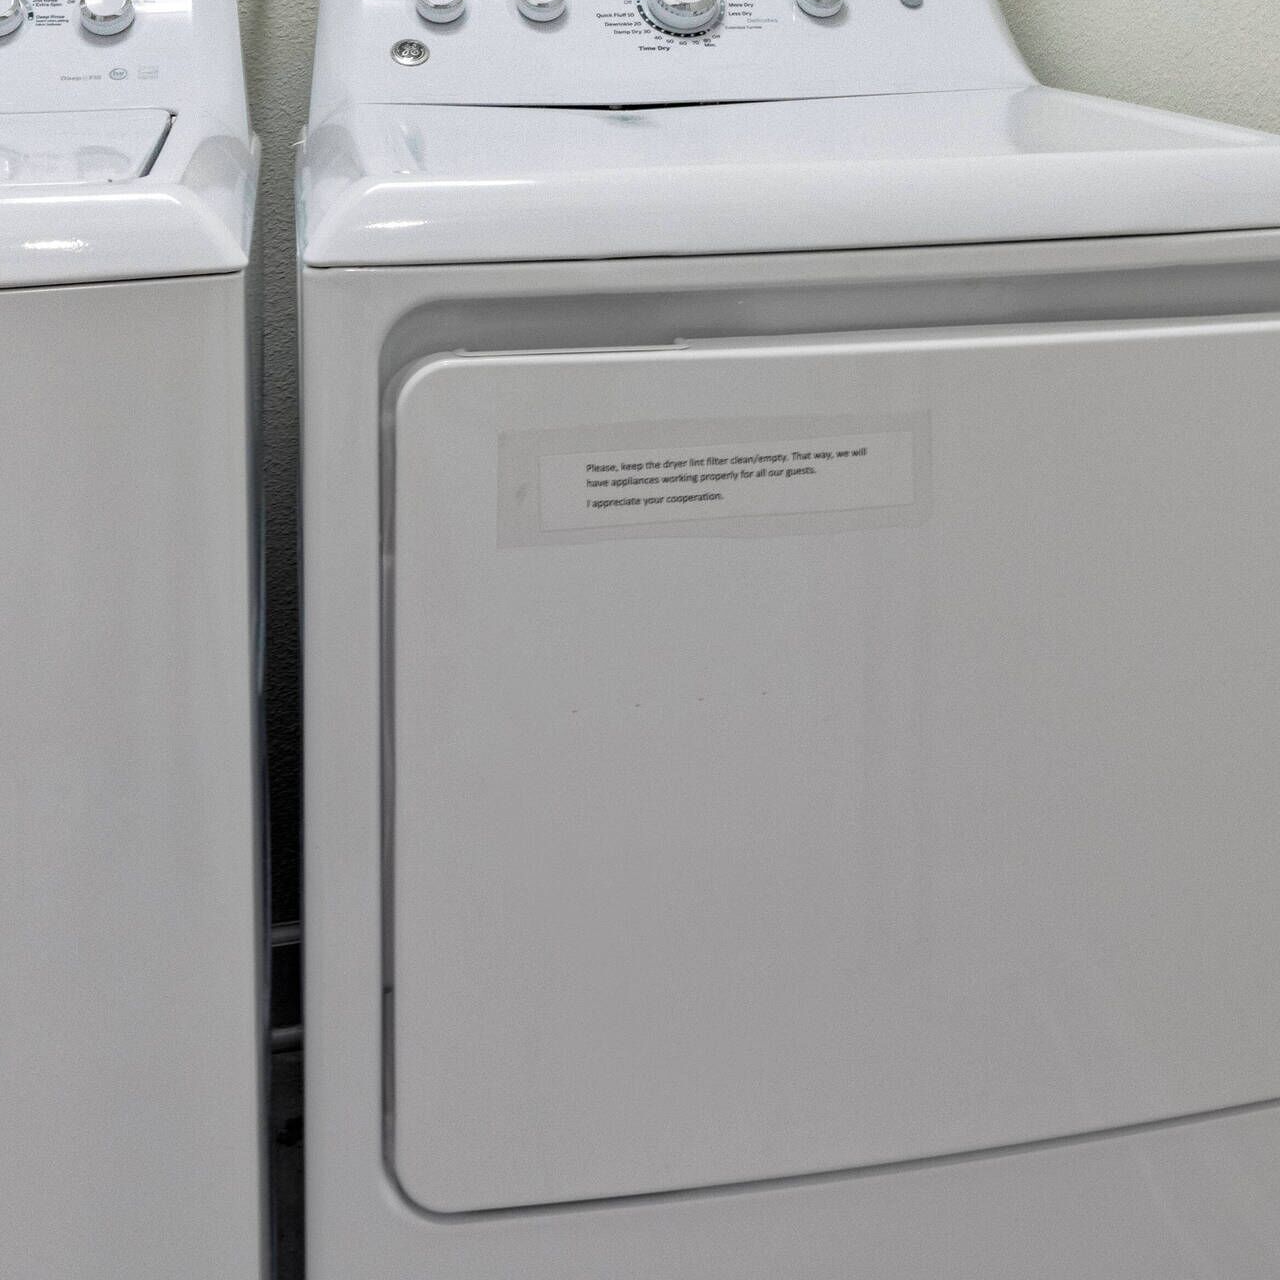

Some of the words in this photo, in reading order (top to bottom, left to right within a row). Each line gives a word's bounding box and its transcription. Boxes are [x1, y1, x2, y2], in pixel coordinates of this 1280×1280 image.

[586, 463, 619, 472] Please,
[621, 462, 643, 471] keep
[645, 461, 660, 469] the
[663, 460, 688, 470] dryer
[689, 458, 704, 467] lint
[707, 457, 728, 466] filter
[730, 454, 788, 465] clean/empty.
[792, 452, 811, 460] That
[814, 452, 834, 461] way,
[851, 448, 867, 456] will
[587, 479, 609, 488] have
[611, 476, 659, 488] appliances
[662, 474, 698, 483] working
[700, 471, 738, 482] properly
[741, 470, 754, 478] for
[756, 468, 766, 478] all
[785, 467, 816, 478] guests.
[592, 497, 641, 509] appreciate
[643, 496, 664, 506] your
[666, 492, 724, 504] cooperation.
